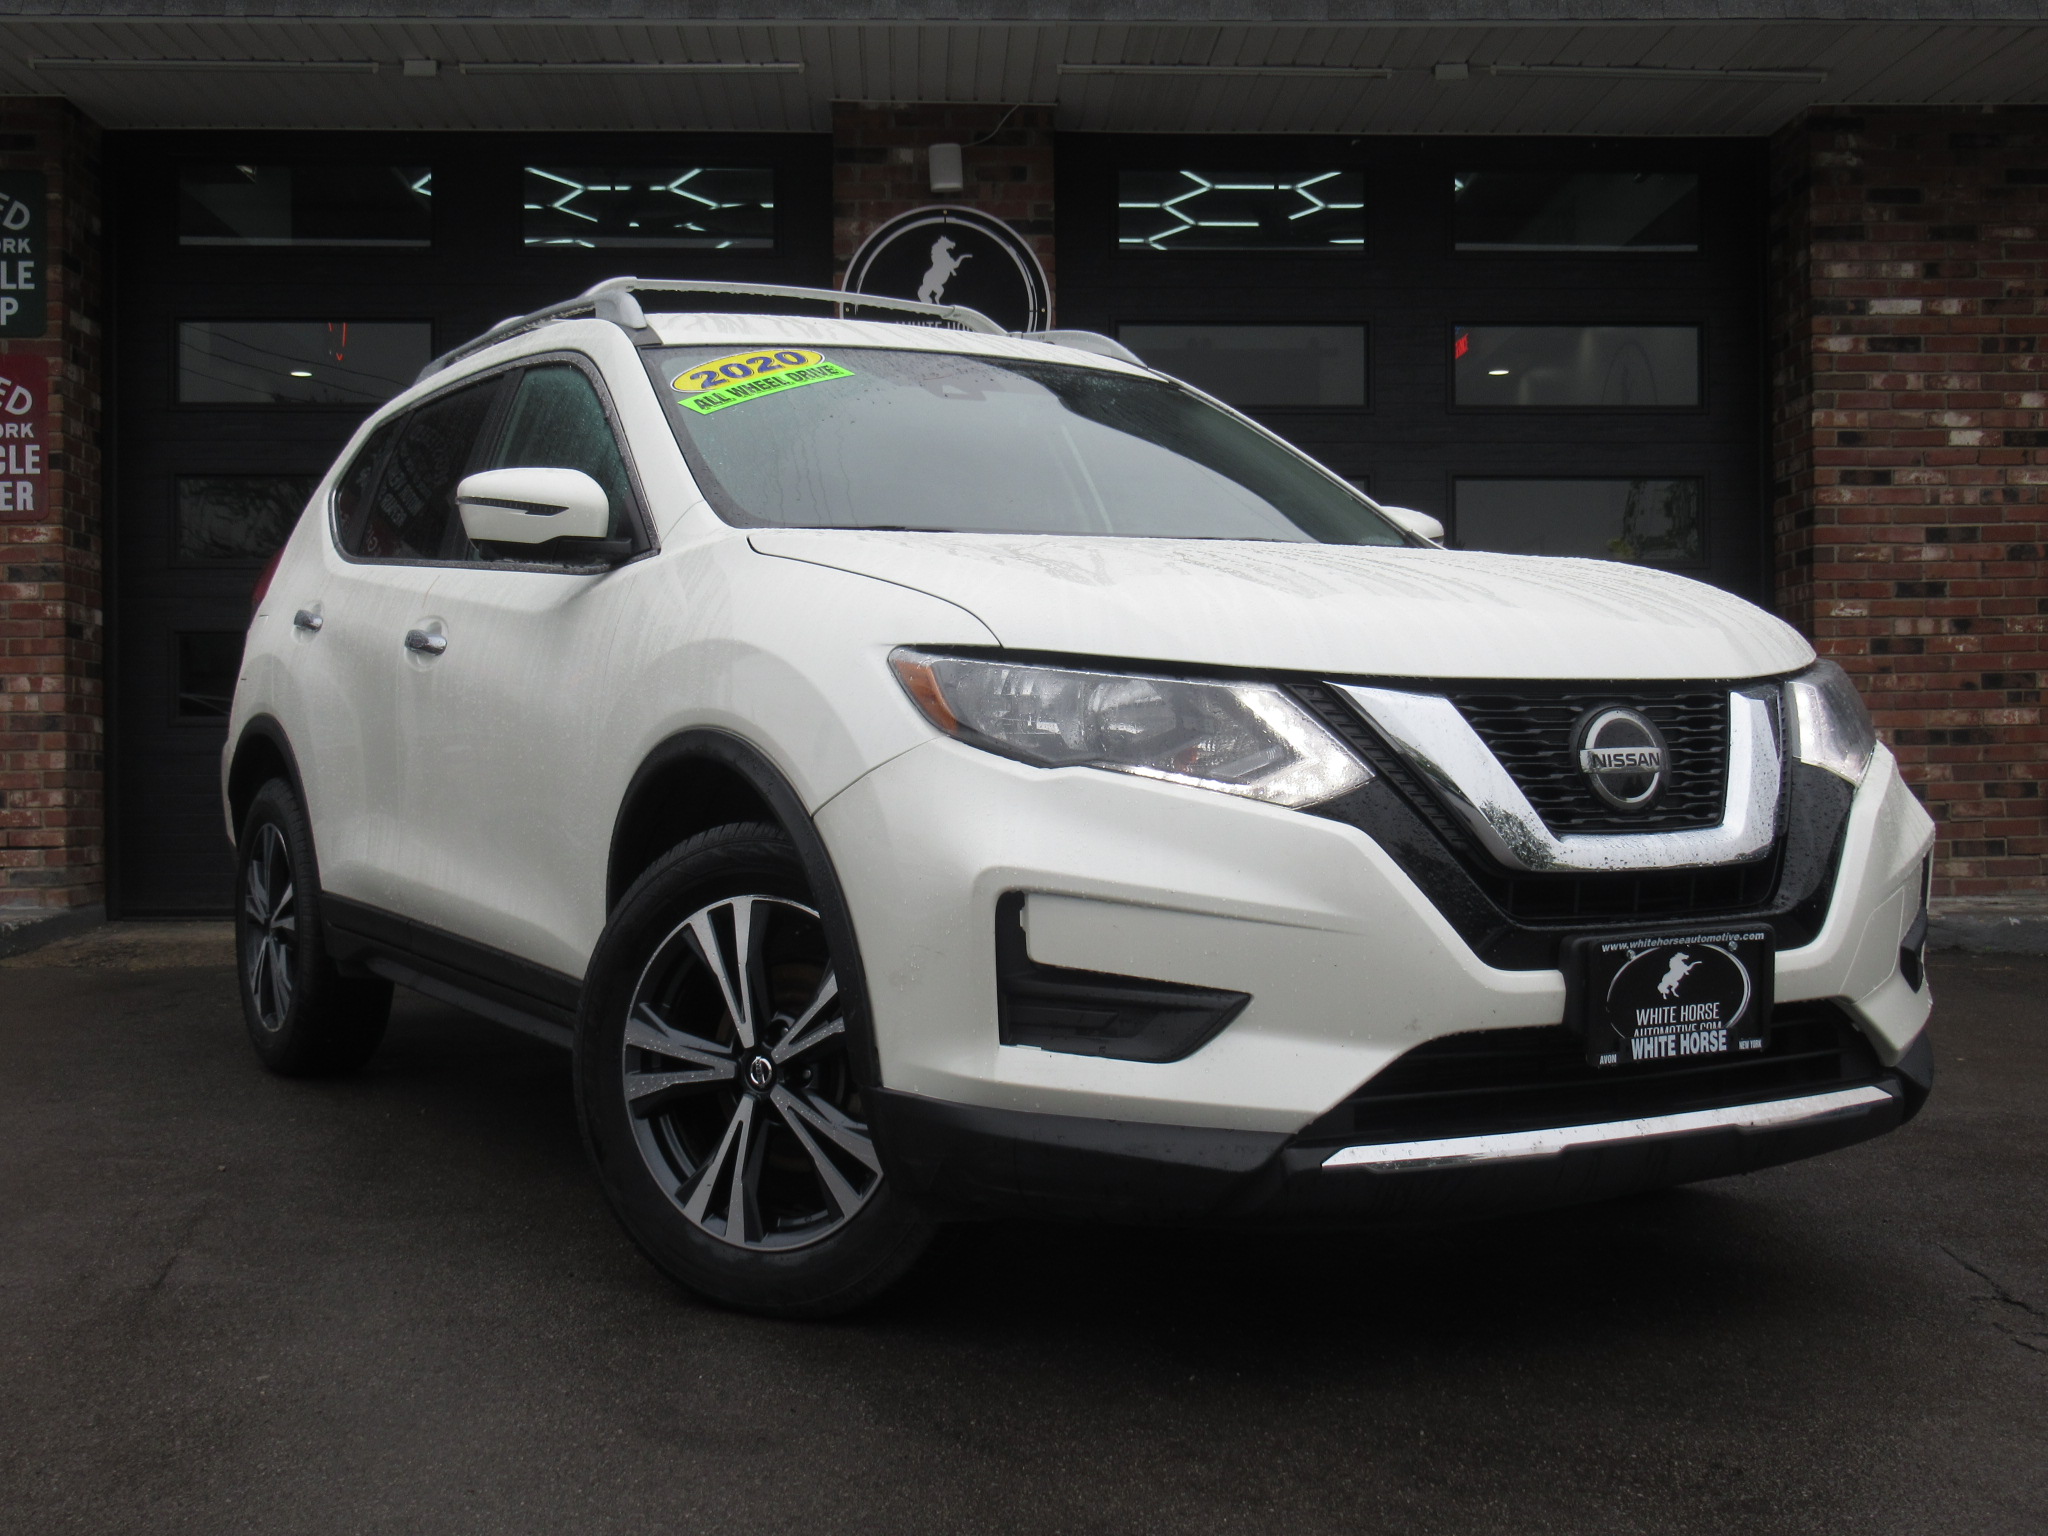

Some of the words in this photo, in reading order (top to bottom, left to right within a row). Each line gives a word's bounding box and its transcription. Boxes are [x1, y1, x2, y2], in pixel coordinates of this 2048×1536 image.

[0, 238, 32, 253] RK
[690, 351, 808, 389] 2020
[693, 390, 731, 410] ALL
[727, 377, 787, 398] WHEEL
[786, 365, 839, 383] DRIVE
[1591, 752, 1660, 768] NISSAN
[1602, 932, 1764, 952] www.whitehorseautomotive.com
[1636, 1006, 1676, 1026] WHITE
[1680, 1002, 1720, 1021] HORSE
[1631, 1034, 1676, 1060] WHITE
[1680, 1029, 1727, 1055] HORSE
[1738, 1040, 1749, 1050] NEW
[1750, 1039, 1762, 1049] YORK
[1599, 1054, 1617, 1065] AVON
